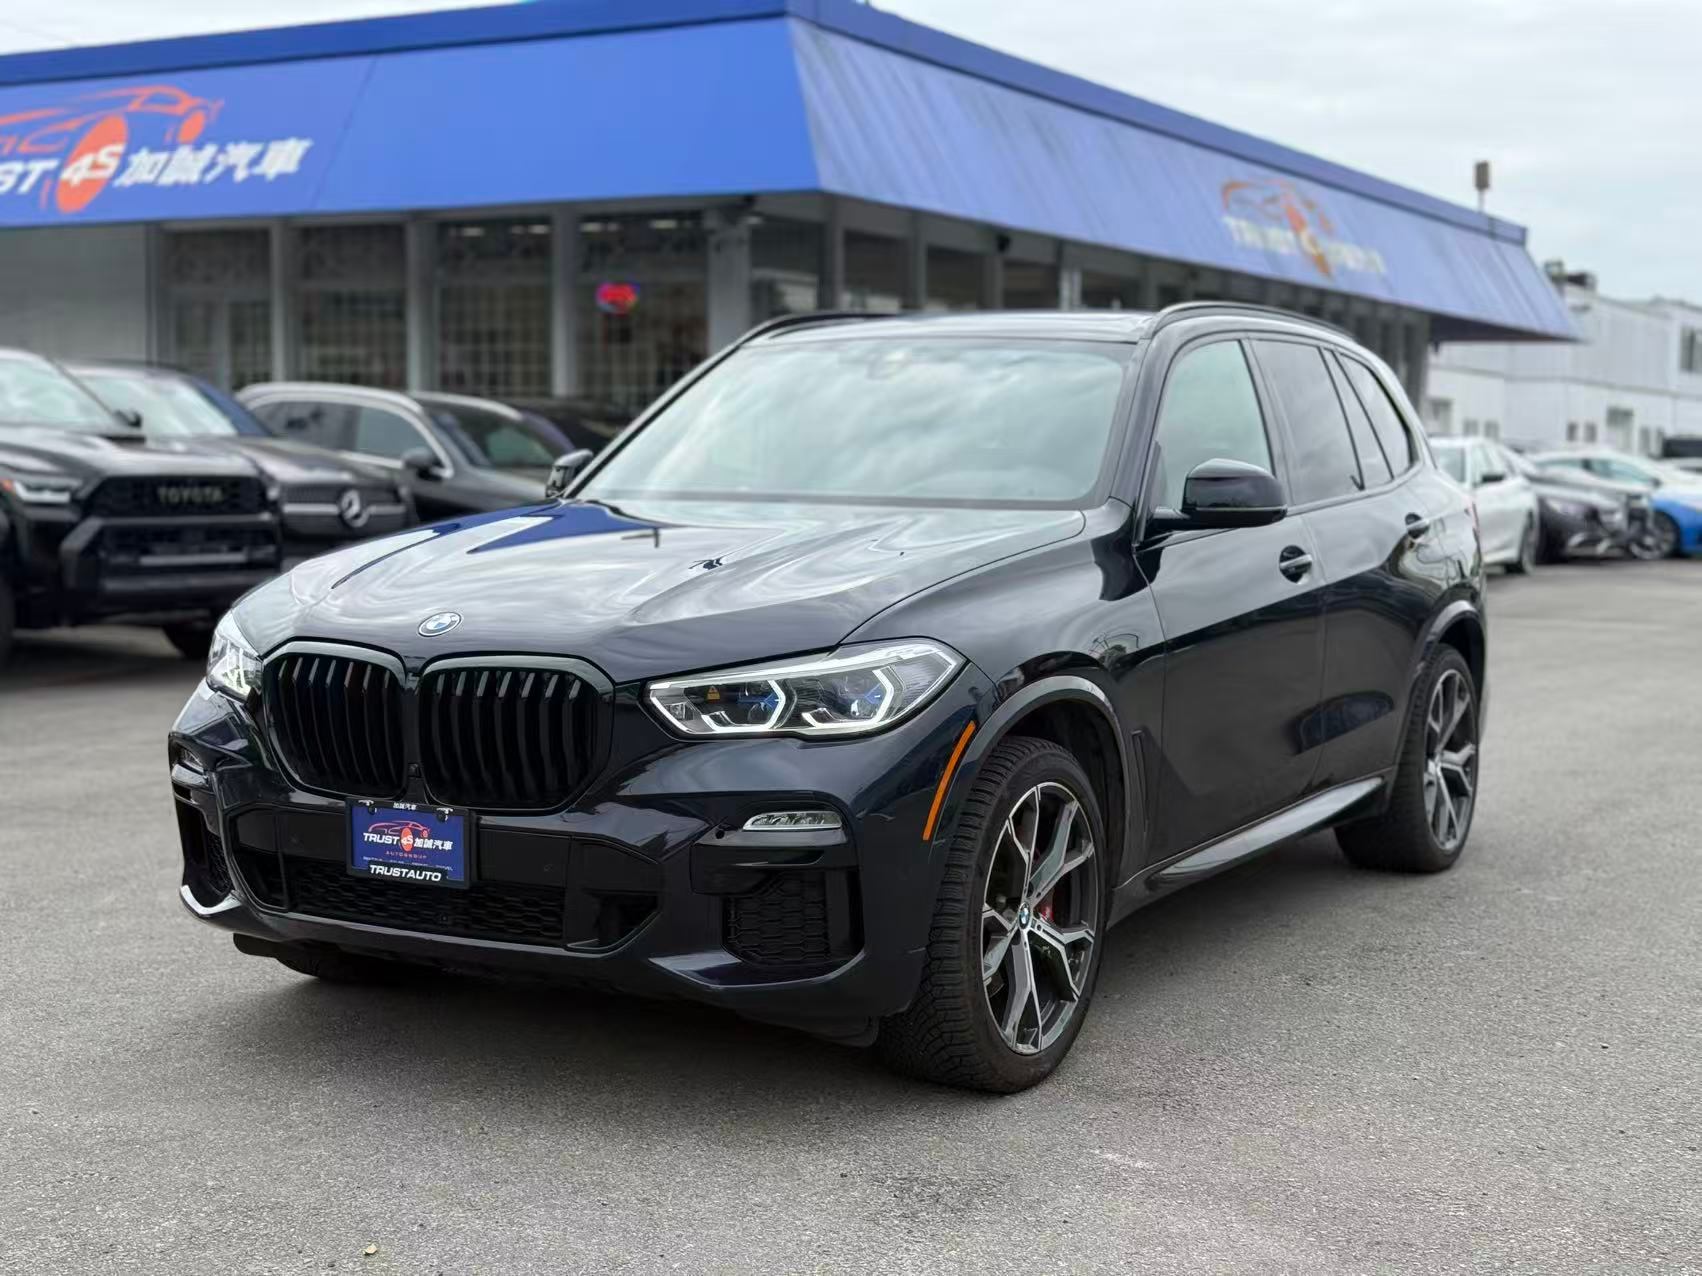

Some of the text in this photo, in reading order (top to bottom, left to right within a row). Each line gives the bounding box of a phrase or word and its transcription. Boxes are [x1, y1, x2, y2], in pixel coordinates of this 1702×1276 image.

[61, 144, 125, 188] 4S
[157, 487, 223, 504] TOYOTA
[363, 832, 400, 845] TRUST
[370, 865, 441, 881] TRUSTAUTO
